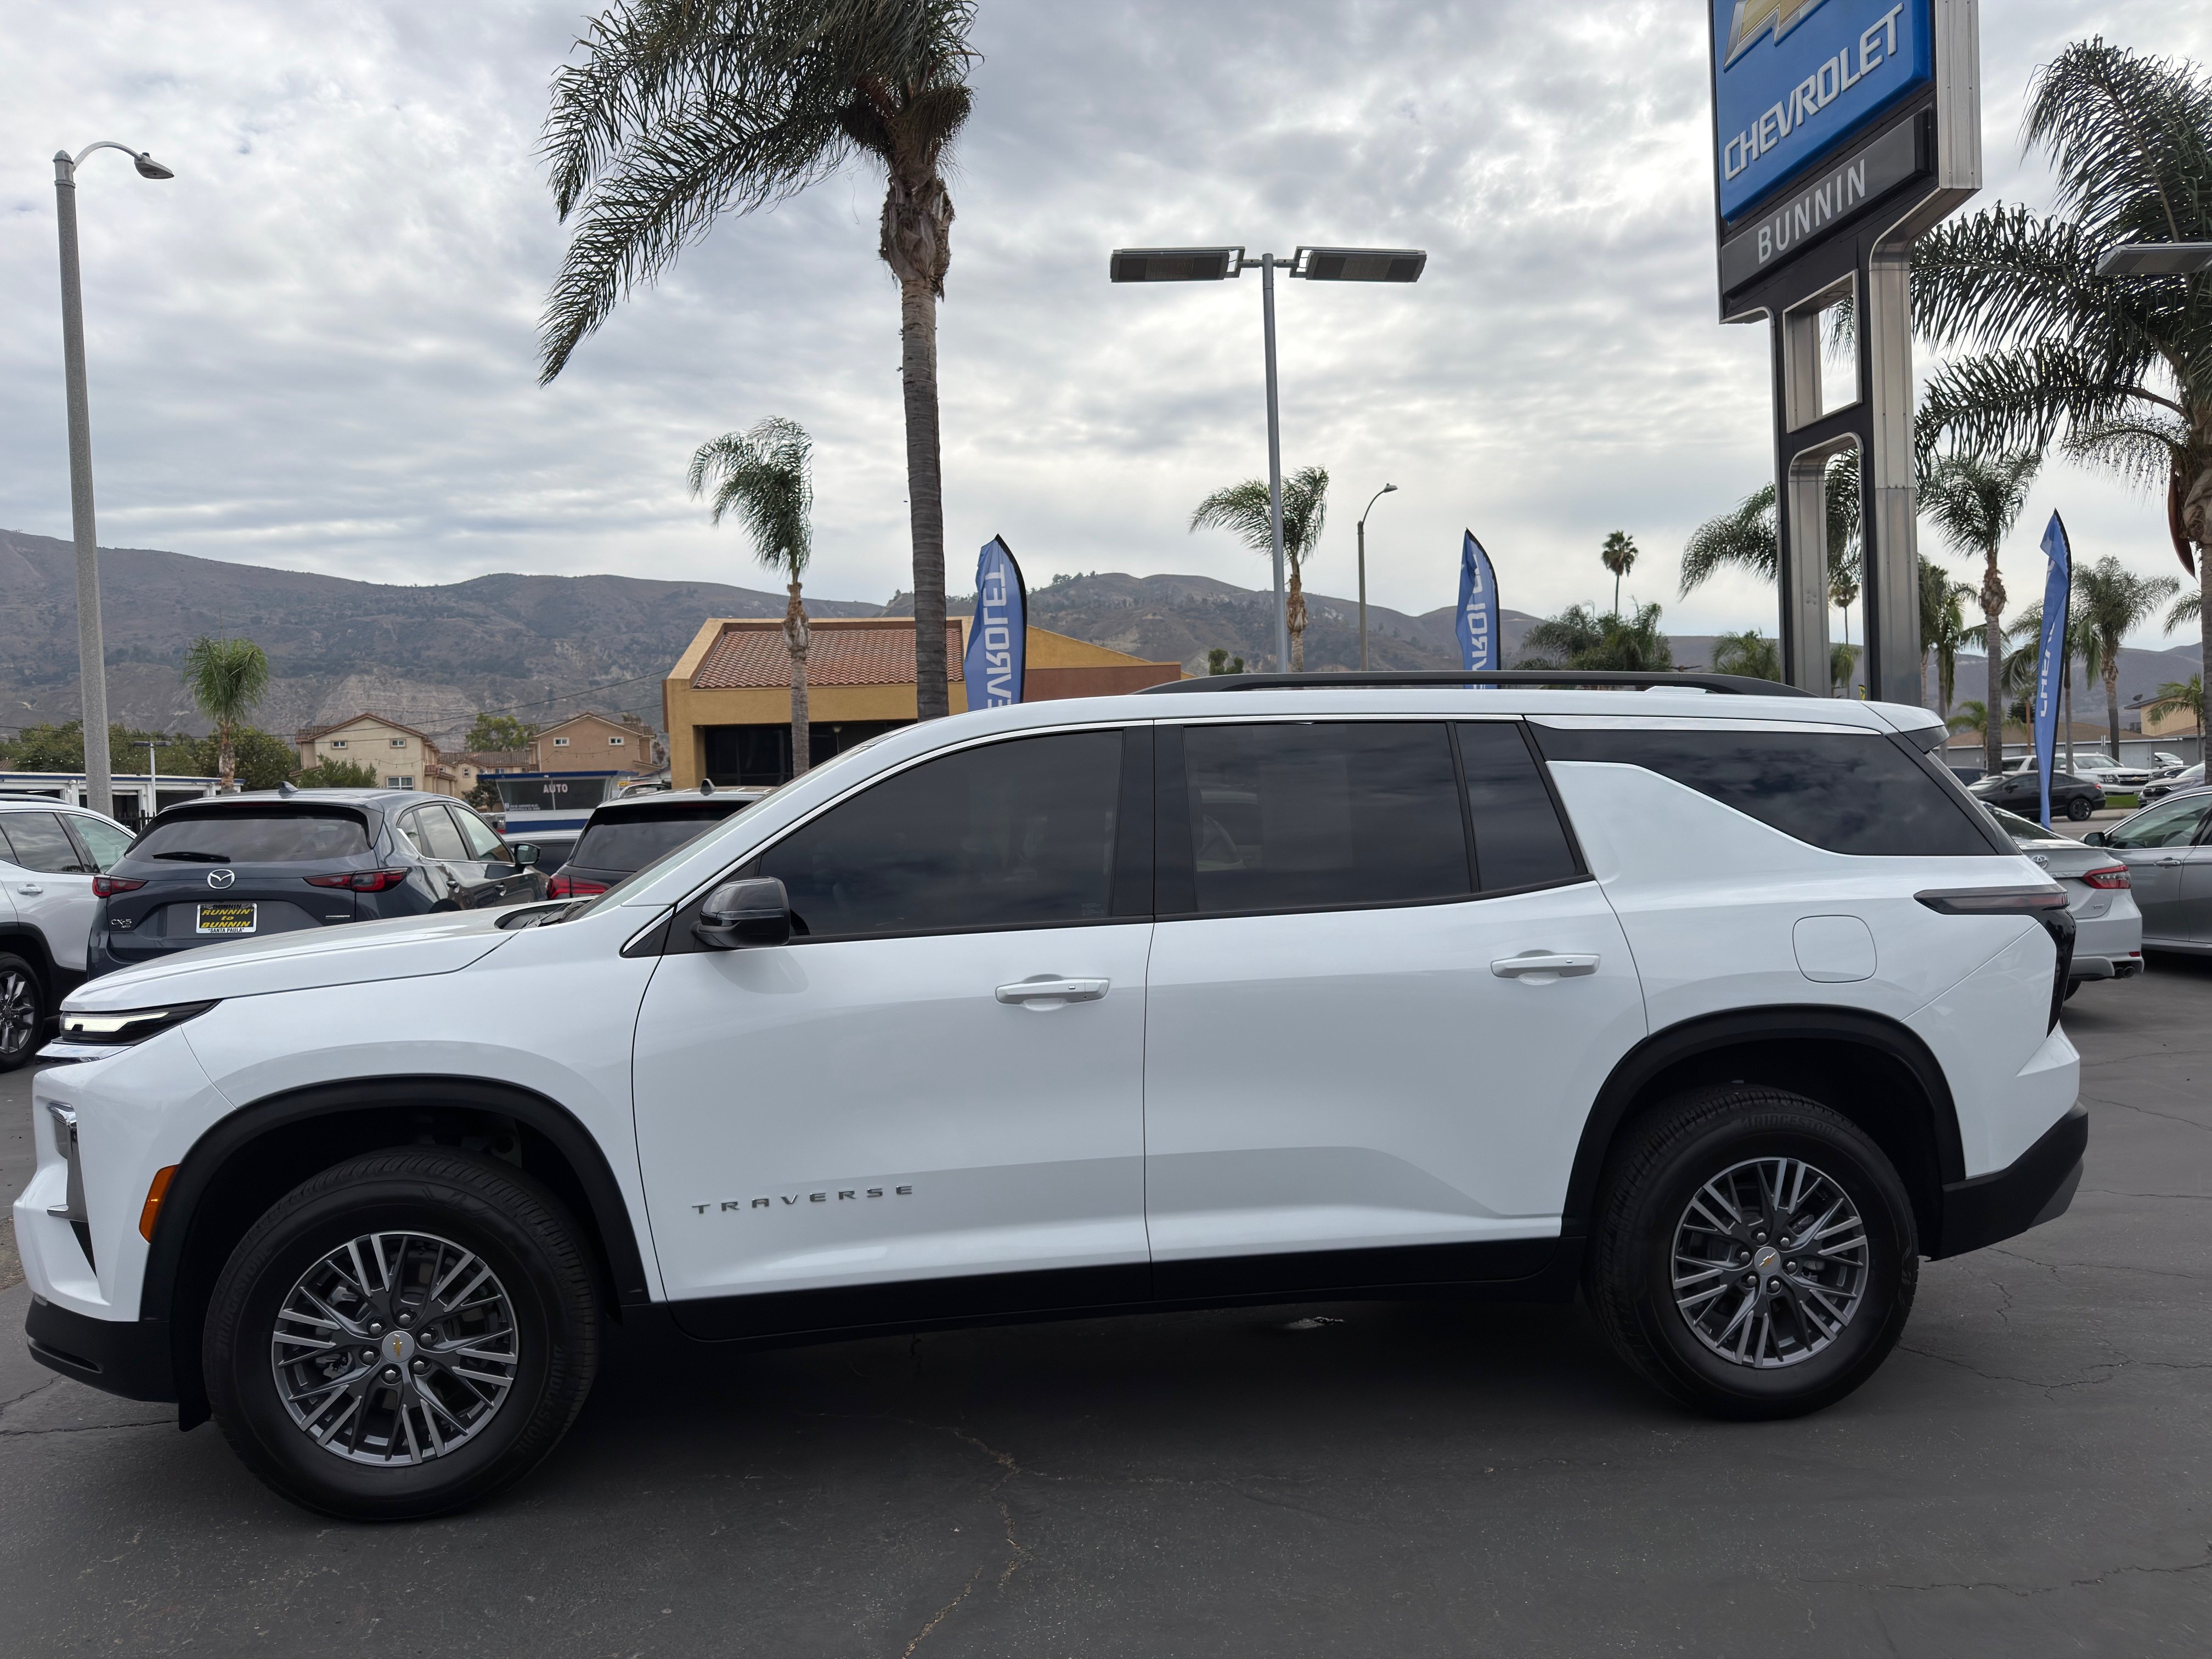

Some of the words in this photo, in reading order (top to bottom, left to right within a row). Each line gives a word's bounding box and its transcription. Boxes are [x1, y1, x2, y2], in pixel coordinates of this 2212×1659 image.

[1724, 3, 1904, 180] CHEVROLET
[1758, 159, 1865, 264] BUNNIN
[543, 783, 568, 793] AUTO
[692, 1184, 913, 1214] TRAVERSE
